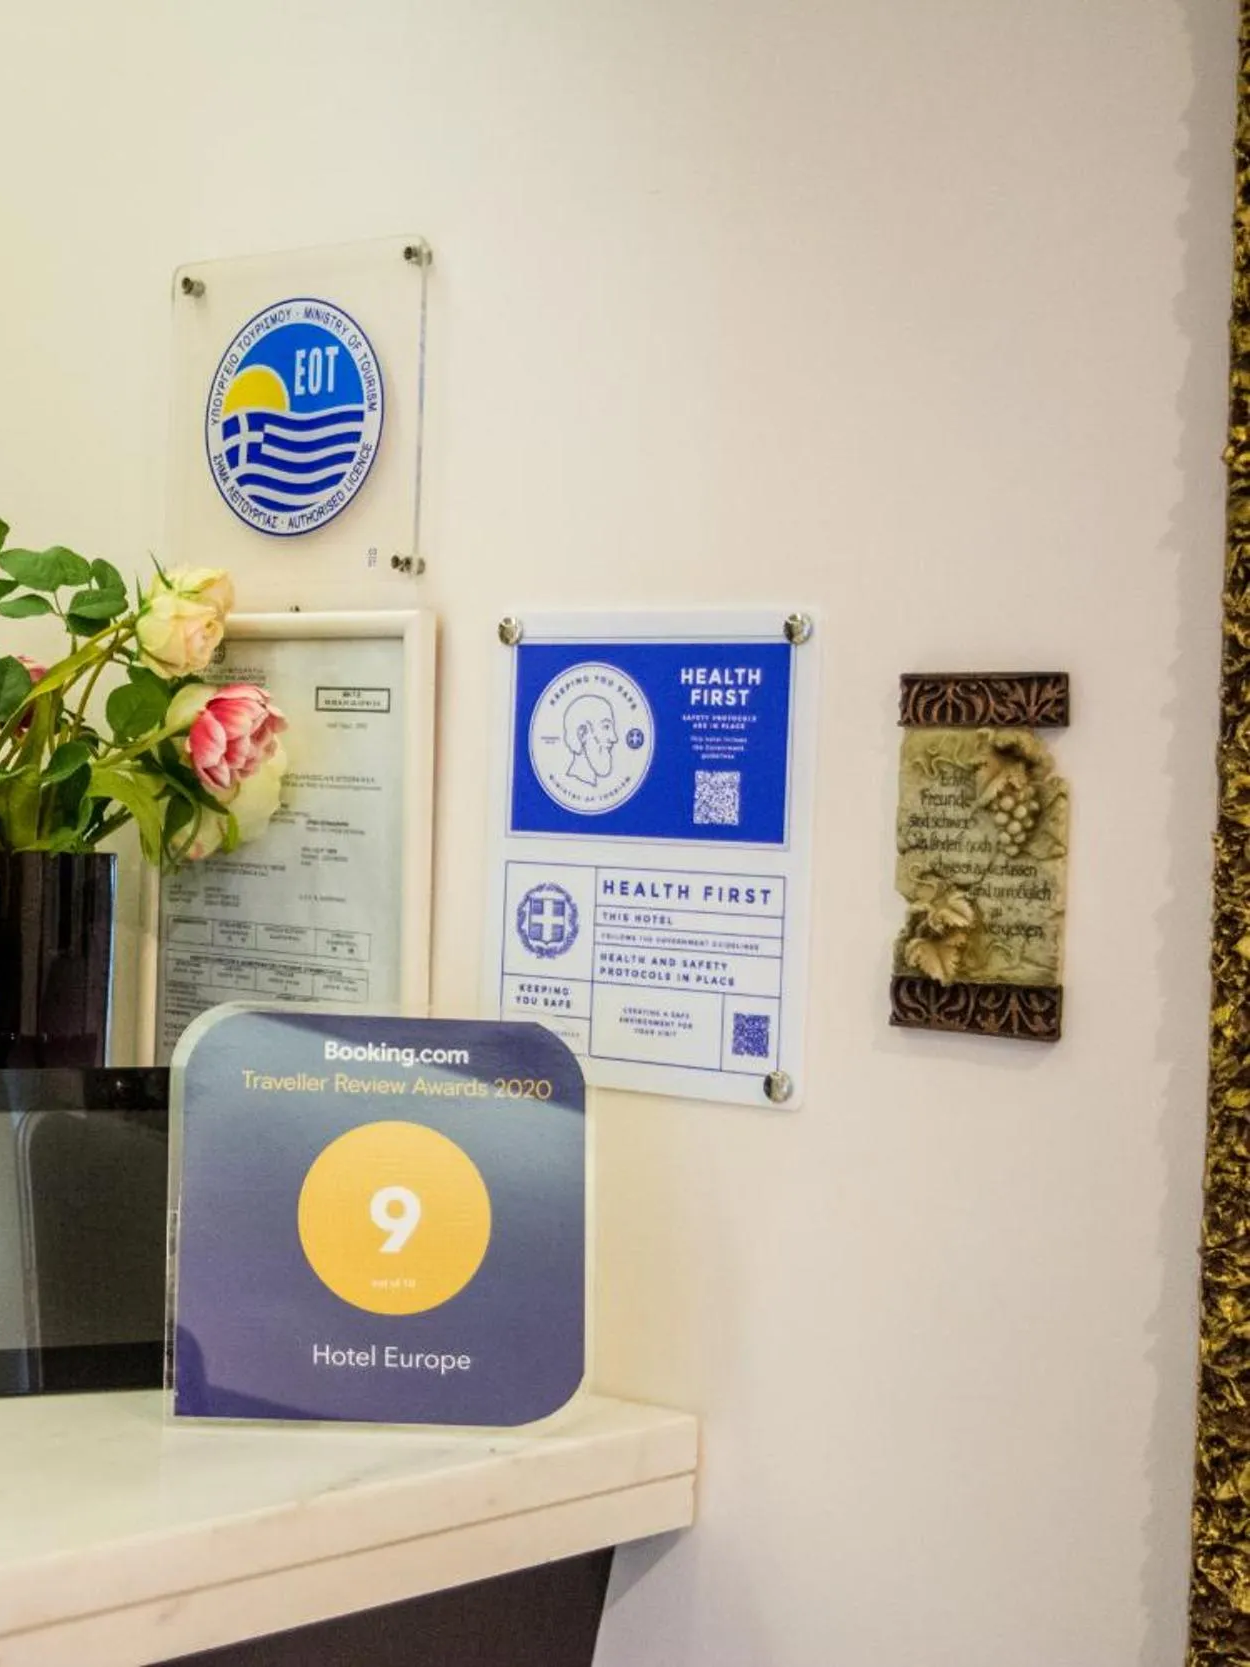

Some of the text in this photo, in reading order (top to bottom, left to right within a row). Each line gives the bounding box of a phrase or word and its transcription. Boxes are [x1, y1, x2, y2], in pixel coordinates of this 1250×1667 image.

[211, 308, 292, 426] ΥΠΟΥΡΓΕΙΟ ΤΟΥΡΙΣΜΟΥ
[304, 306, 378, 412] MINISTRY OF TOURISM
[213, 453, 230, 486] ΣΗΜΑ
[287, 441, 373, 530] AUTHORISED LICENCE
[680, 667, 762, 686] HEALTH
[690, 689, 750, 706] FIRST
[603, 880, 772, 904] HEALTH FIRST
[602, 911, 674, 926] THIS HOTEL
[600, 952, 729, 972] HEALTH AND SAFETY
[518, 983, 572, 996] KEEPING
[599, 966, 736, 988] PROTOCOLS IN PLACE
[516, 996, 572, 1009] YOU SAFE
[324, 1040, 470, 1067] Booking.com
[242, 1070, 553, 1101] Traveller Review Awards 2020
[369, 1185, 422, 1254] 9
[313, 1344, 472, 1375] Hotel Europe
